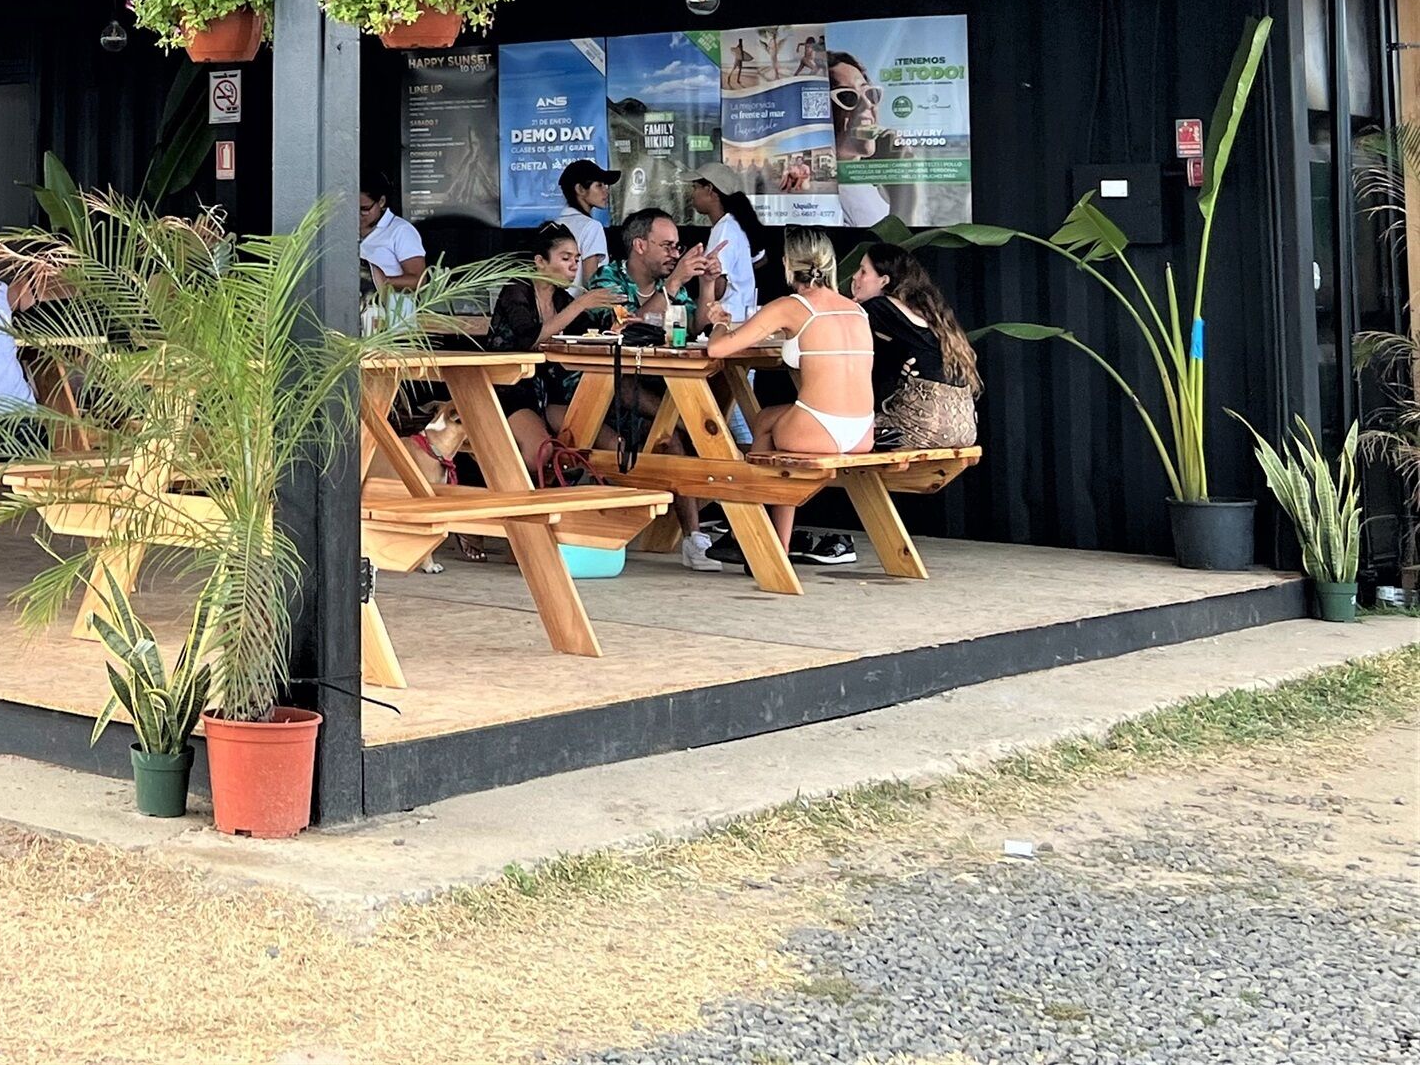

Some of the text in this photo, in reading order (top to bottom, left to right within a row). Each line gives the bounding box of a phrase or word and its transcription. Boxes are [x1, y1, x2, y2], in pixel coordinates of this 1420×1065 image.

[408, 53, 492, 69] HAPPY SUNSET
[894, 56, 946, 66] ¡TENEMOS
[879, 65, 965, 82] DE TODO!
[408, 84, 443, 94] LINE UP
[536, 96, 568, 107] ANS
[739, 101, 759, 112] mejor
[759, 100, 775, 110] vida
[739, 110, 760, 119] frente
[760, 109, 768, 118] al
[769, 110, 786, 118] mar
[549, 117, 572, 125] ENERO
[644, 123, 675, 135] FAMILY
[896, 128, 944, 137] DELIVERY
[511, 126, 595, 143] DEMO DAY
[644, 135, 675, 148] HIKING
[511, 146, 536, 154] CLASES
[568, 144, 595, 152] GRATIS
[510, 161, 548, 171] GENETZA
